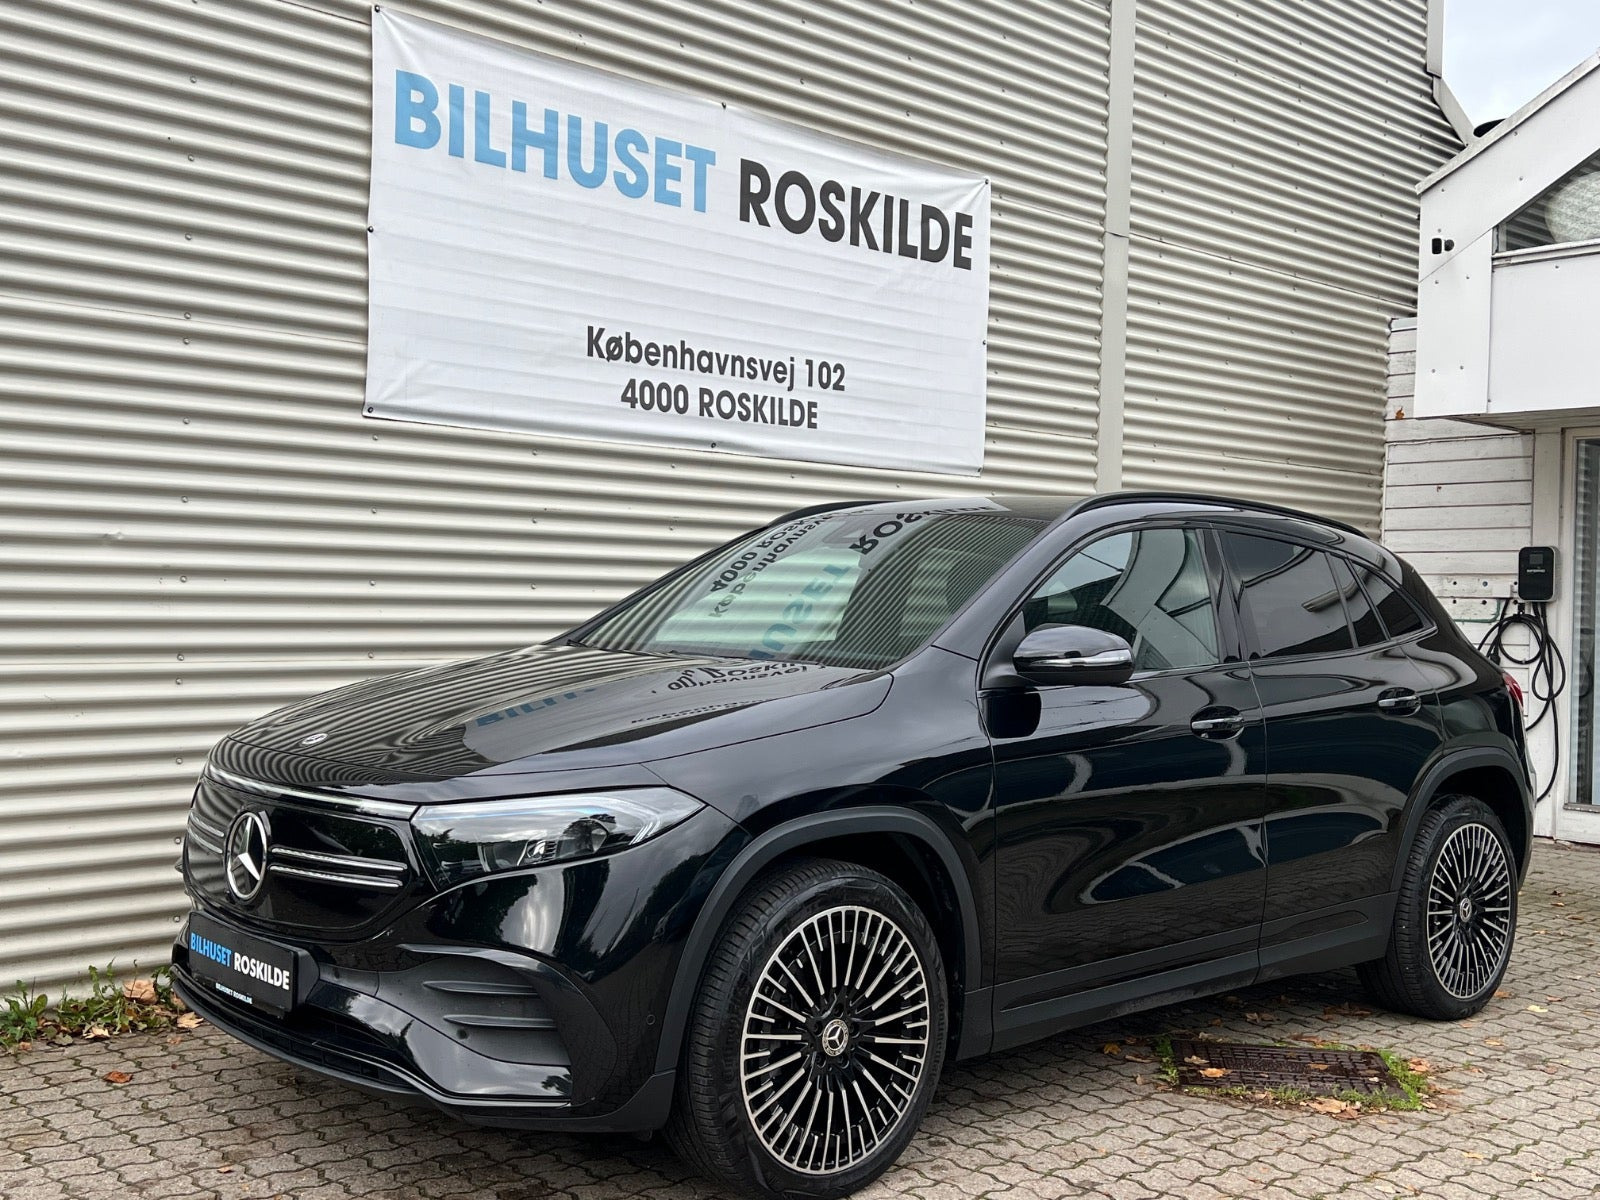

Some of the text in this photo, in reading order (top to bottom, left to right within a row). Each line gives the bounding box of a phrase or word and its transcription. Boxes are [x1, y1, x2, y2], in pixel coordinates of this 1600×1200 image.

[394, 69, 974, 271] BILHUSET ROSKILDE
[586, 325, 847, 392] Københavnsvej 102
[620, 378, 819, 430] 4000 ROSKILDE
[190, 932, 290, 991] BILHUSET ROSKILDE
